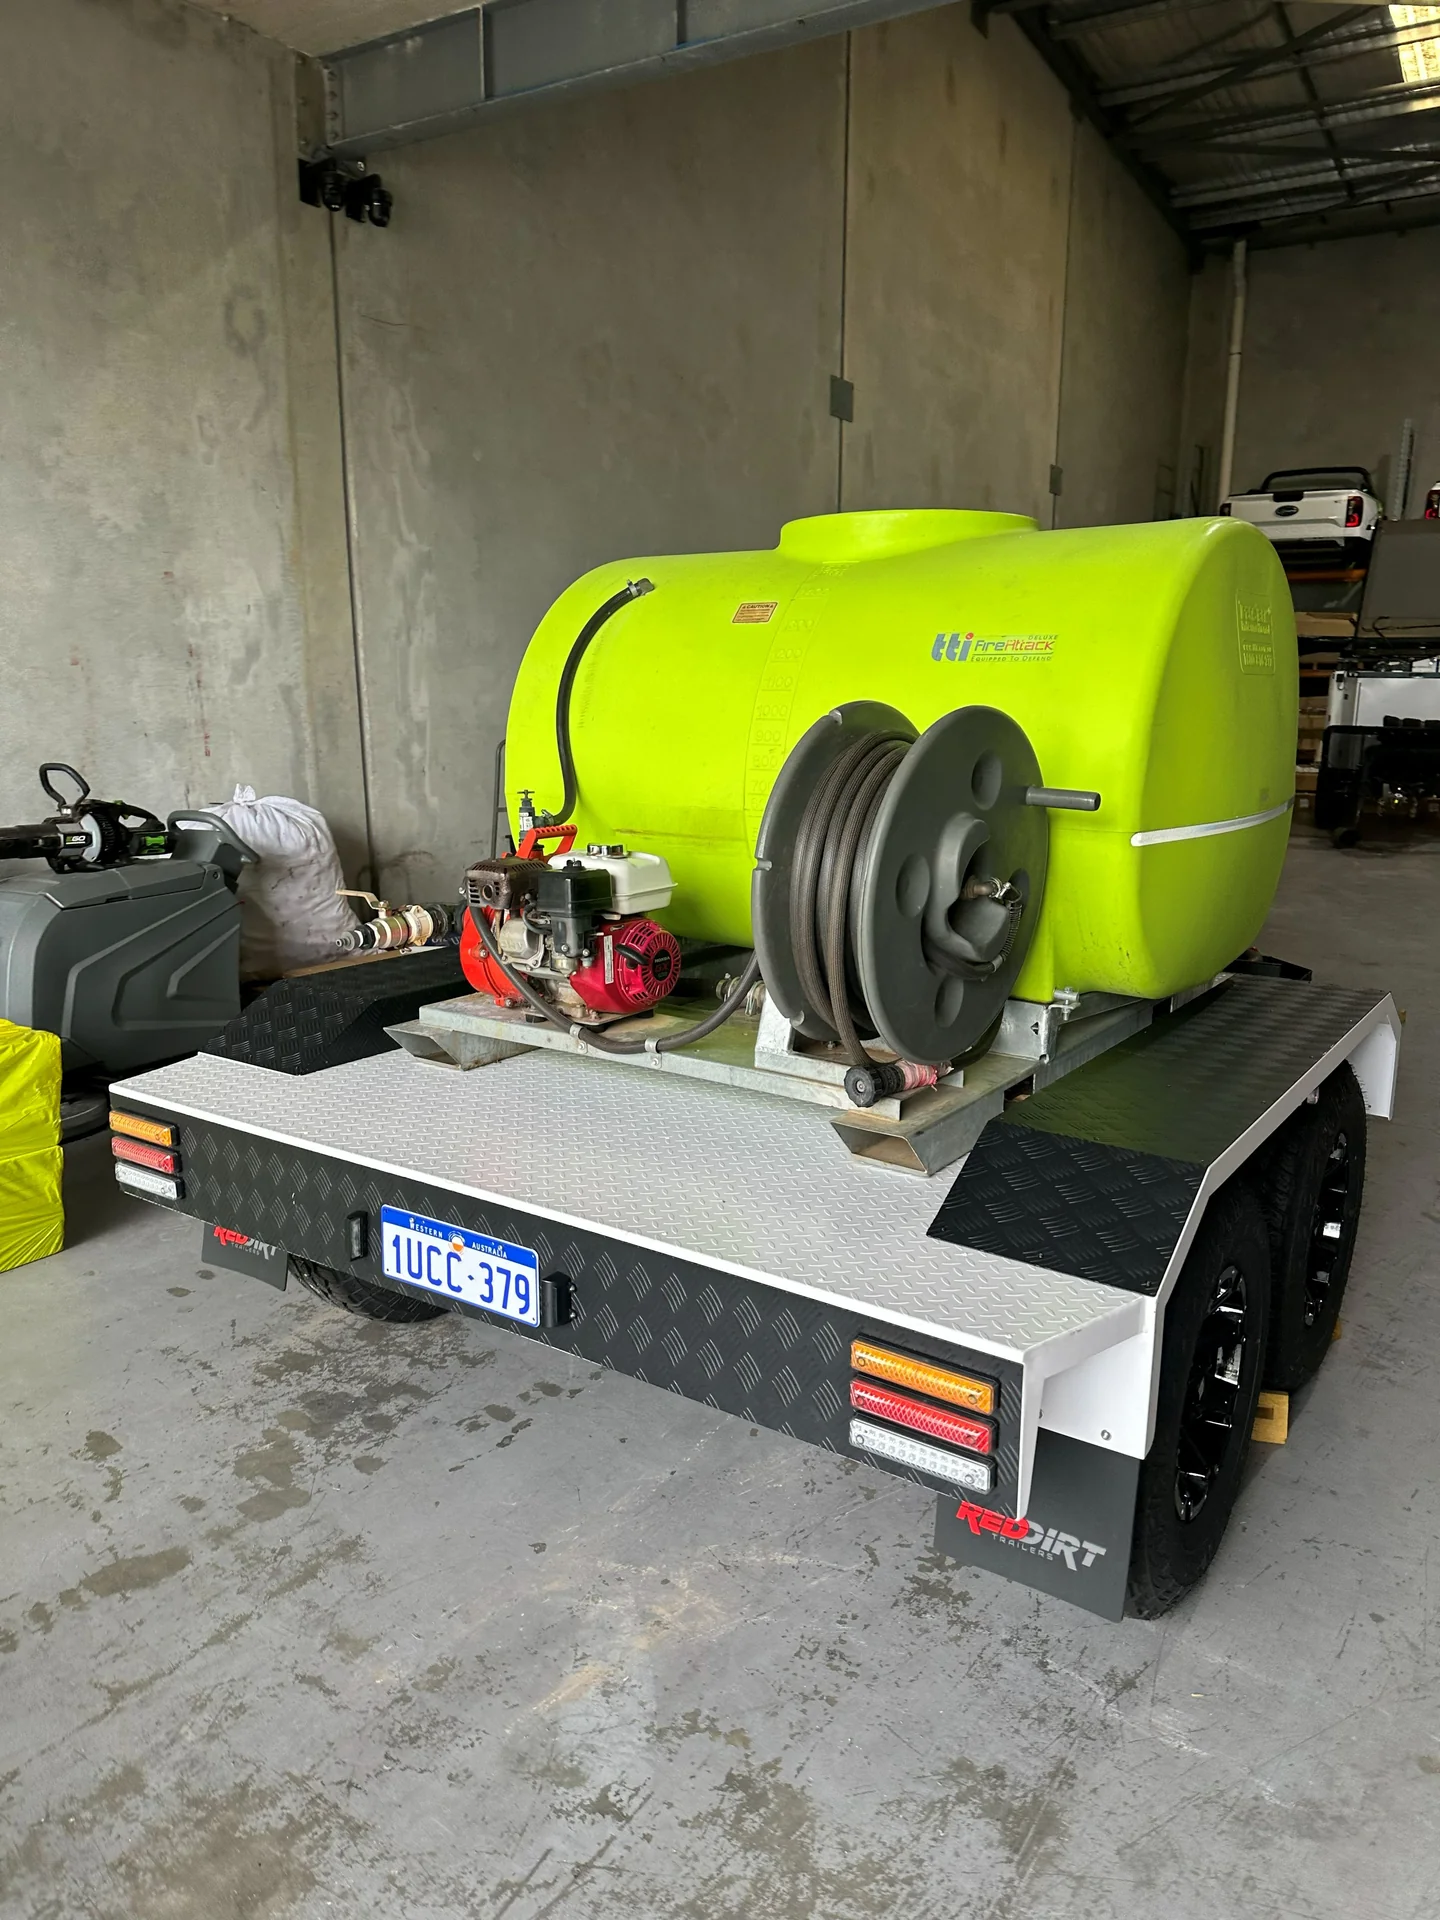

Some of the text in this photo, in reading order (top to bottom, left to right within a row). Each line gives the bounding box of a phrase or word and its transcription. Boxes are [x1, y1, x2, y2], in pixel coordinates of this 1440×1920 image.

[755, 730, 782, 743] 900
[409, 1222, 508, 1259] WESTERN AUSTRALIA
[991, 1533, 1054, 1561] TRAILERS
